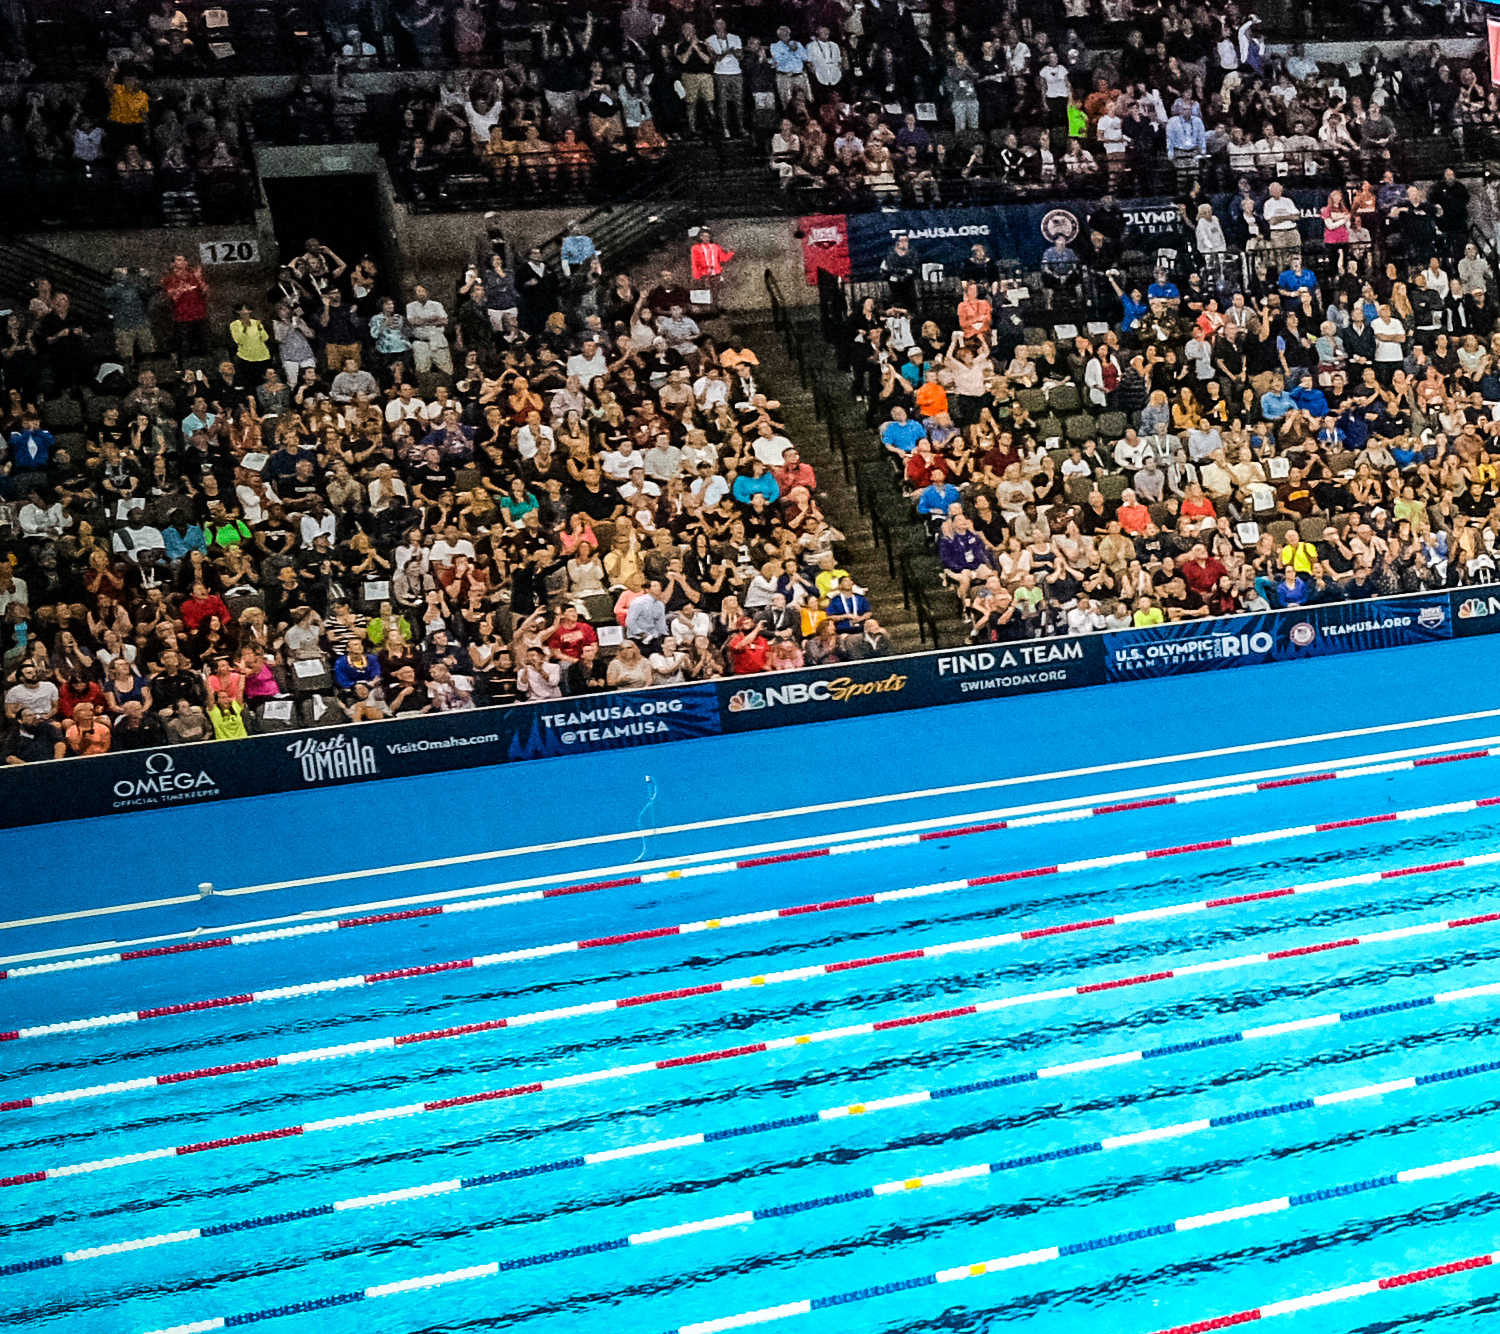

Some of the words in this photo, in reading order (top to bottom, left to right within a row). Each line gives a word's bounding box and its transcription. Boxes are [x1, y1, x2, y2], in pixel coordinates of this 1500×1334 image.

[206, 243, 252, 262] 120
[1322, 617, 1411, 636] TEAMUSA.ORG
[938, 653, 995, 675] FIND
[1000, 650, 1018, 667] A
[1020, 641, 1083, 664] TEAM
[1116, 650, 1143, 661] U.S.
[1147, 640, 1213, 658] OLYMPIC
[1222, 632, 1273, 657] RIO
[1117, 660, 1155, 670] TEAM
[1164, 652, 1212, 664] TRIALS
[961, 670, 1067, 692] SWIMTODAY.ORG
[541, 697, 683, 729] TEAMUSA.ORG
[561, 721, 669, 745] @TEAMUSA
[287, 734, 347, 758] Visit
[301, 737, 377, 782] OMAHA
[386, 733, 498, 755] VisitOmaha.com
[114, 771, 215, 797] OMEGA
